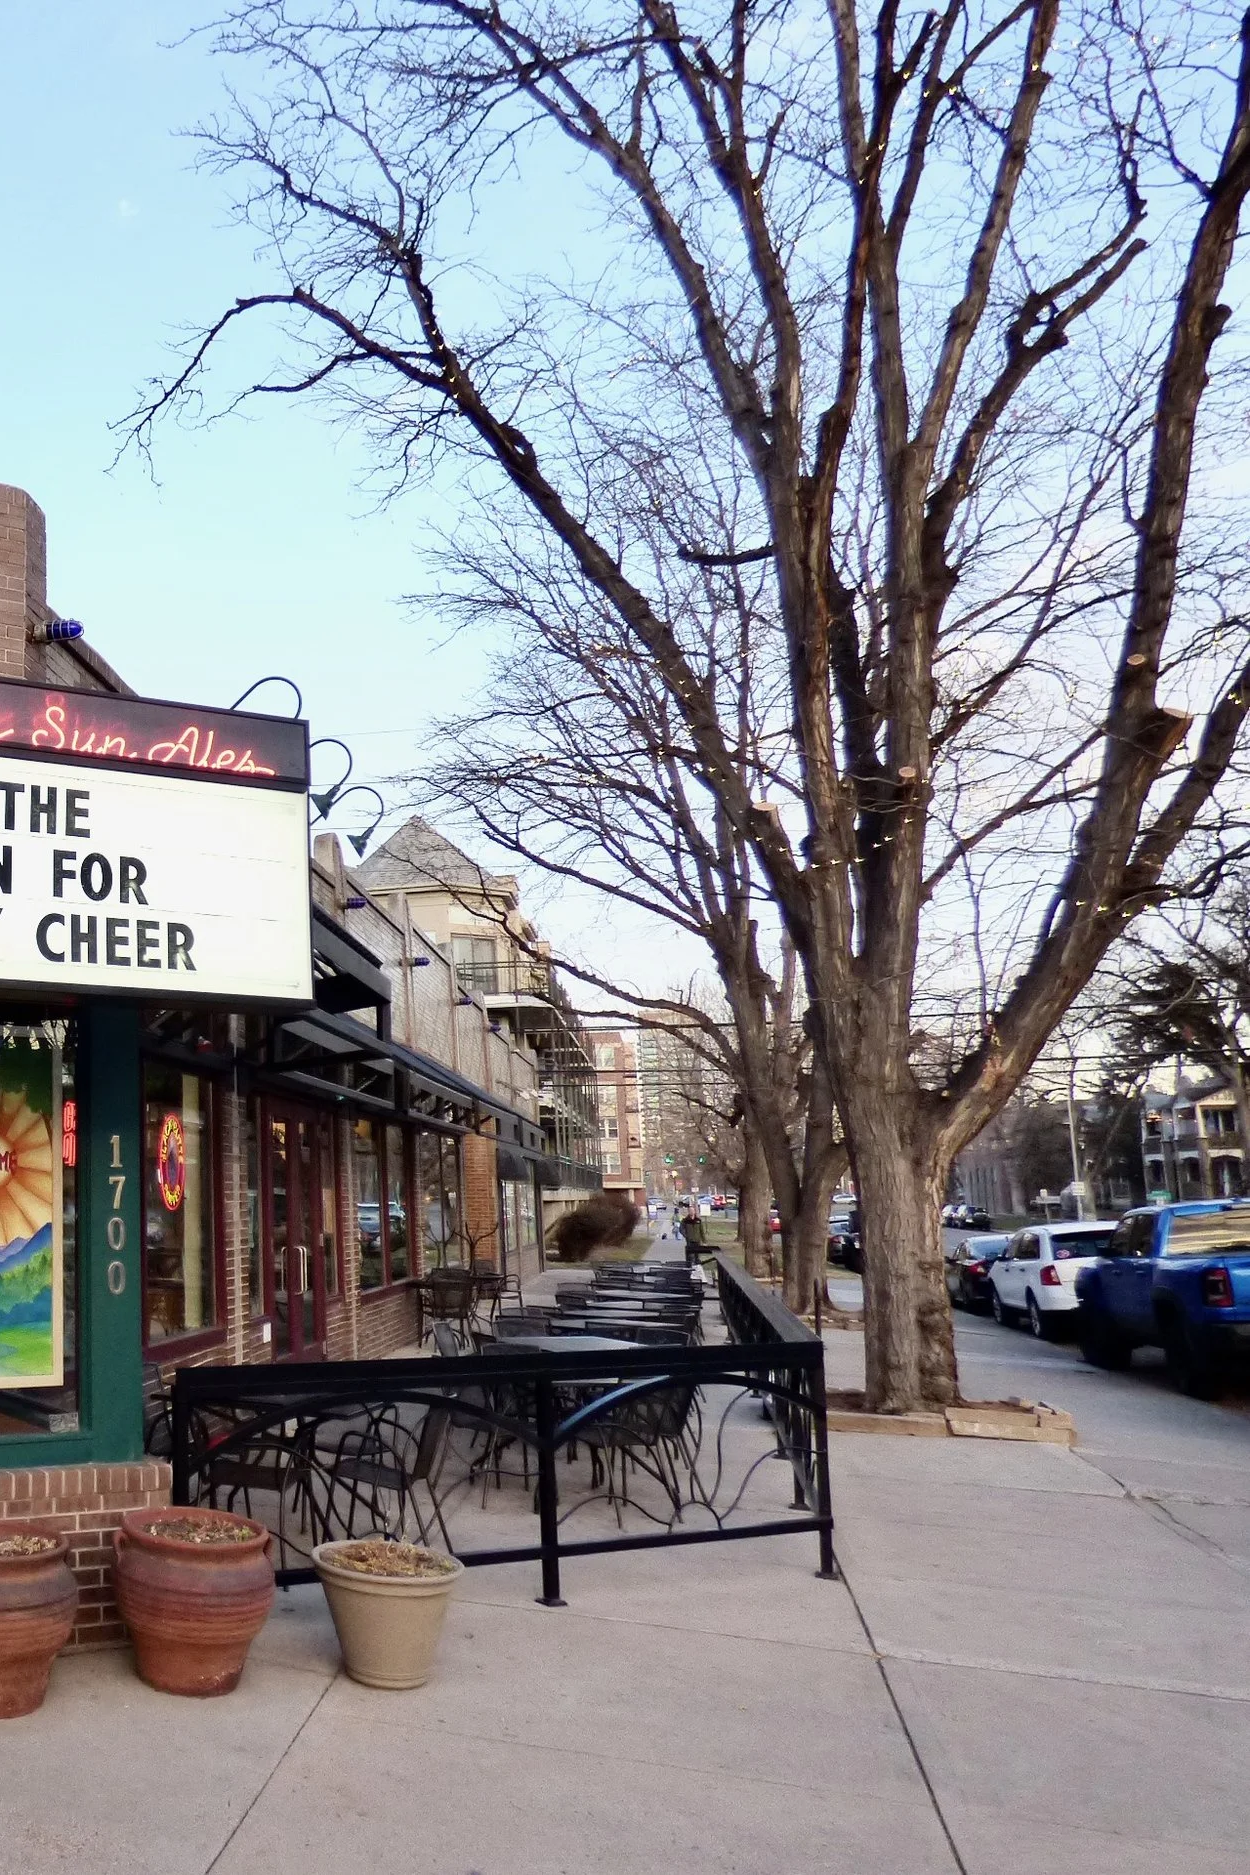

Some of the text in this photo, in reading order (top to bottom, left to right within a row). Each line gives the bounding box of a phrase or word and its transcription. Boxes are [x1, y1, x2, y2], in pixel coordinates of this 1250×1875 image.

[32, 706, 138, 758] Sun
[148, 726, 276, 776] Ales
[53, 849, 149, 905] FOR
[36, 913, 198, 971] CHEER
[107, 1135, 126, 1295] 1700
